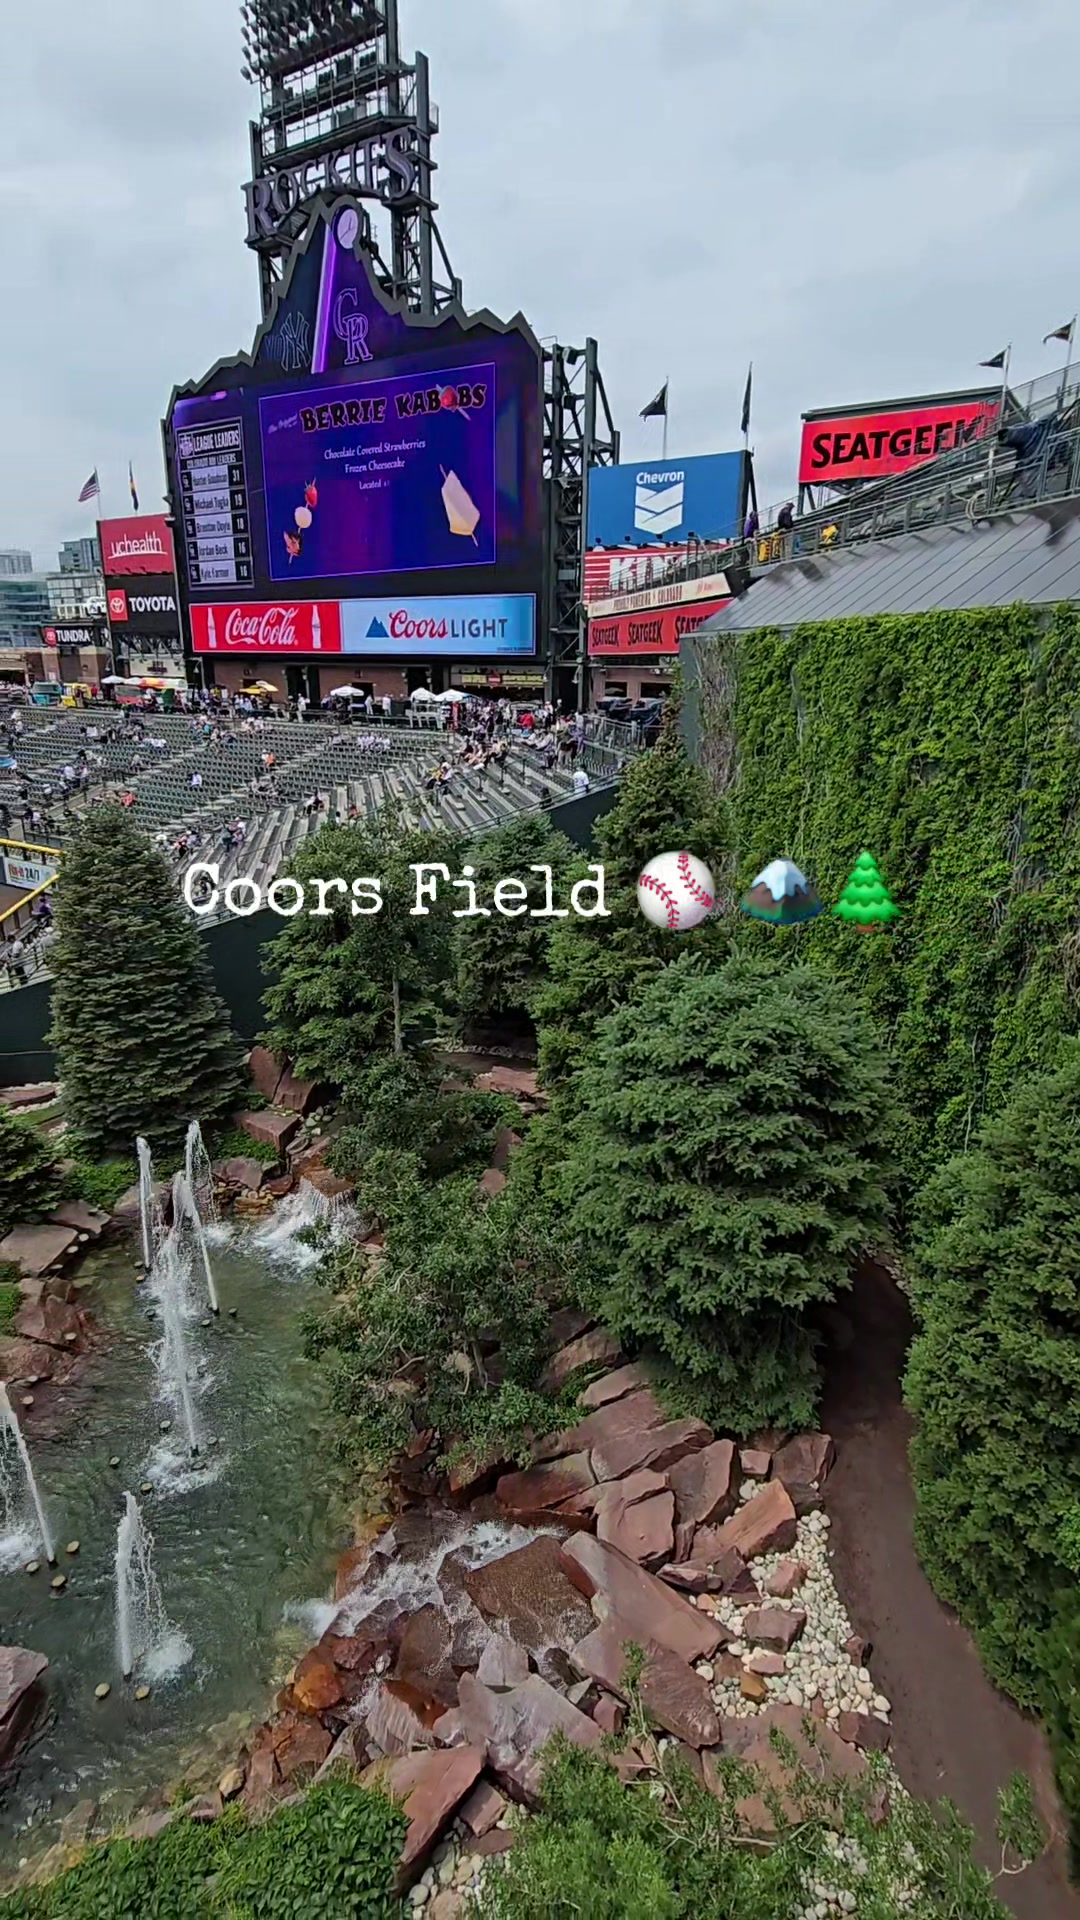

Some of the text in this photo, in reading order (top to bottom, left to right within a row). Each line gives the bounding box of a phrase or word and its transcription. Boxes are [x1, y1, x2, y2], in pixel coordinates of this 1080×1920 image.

[240, 126, 417, 243] ROCKIES
[300, 398, 387, 433] BERRIE
[193, 430, 239, 452] LEAGUE LEADERS
[324, 438, 426, 460] Chocolate Covered Strawberries
[811, 414, 985, 469] SEATGEEK
[232, 468, 240, 482] 31
[345, 456, 406, 474] Frozen Cheesecake
[359, 478, 382, 490] Located
[636, 471, 685, 485] Chevron
[111, 531, 162, 557] uchealth
[129, 596, 177, 612] TOYOTA
[225, 607, 299, 646] Coca-Cola
[388, 609, 508, 639] Coors LIGHT
[592, 623, 620, 648] SEATGEEK
[628, 617, 664, 646] SEATGEEK
[55, 629, 91, 643] TUNDRA
